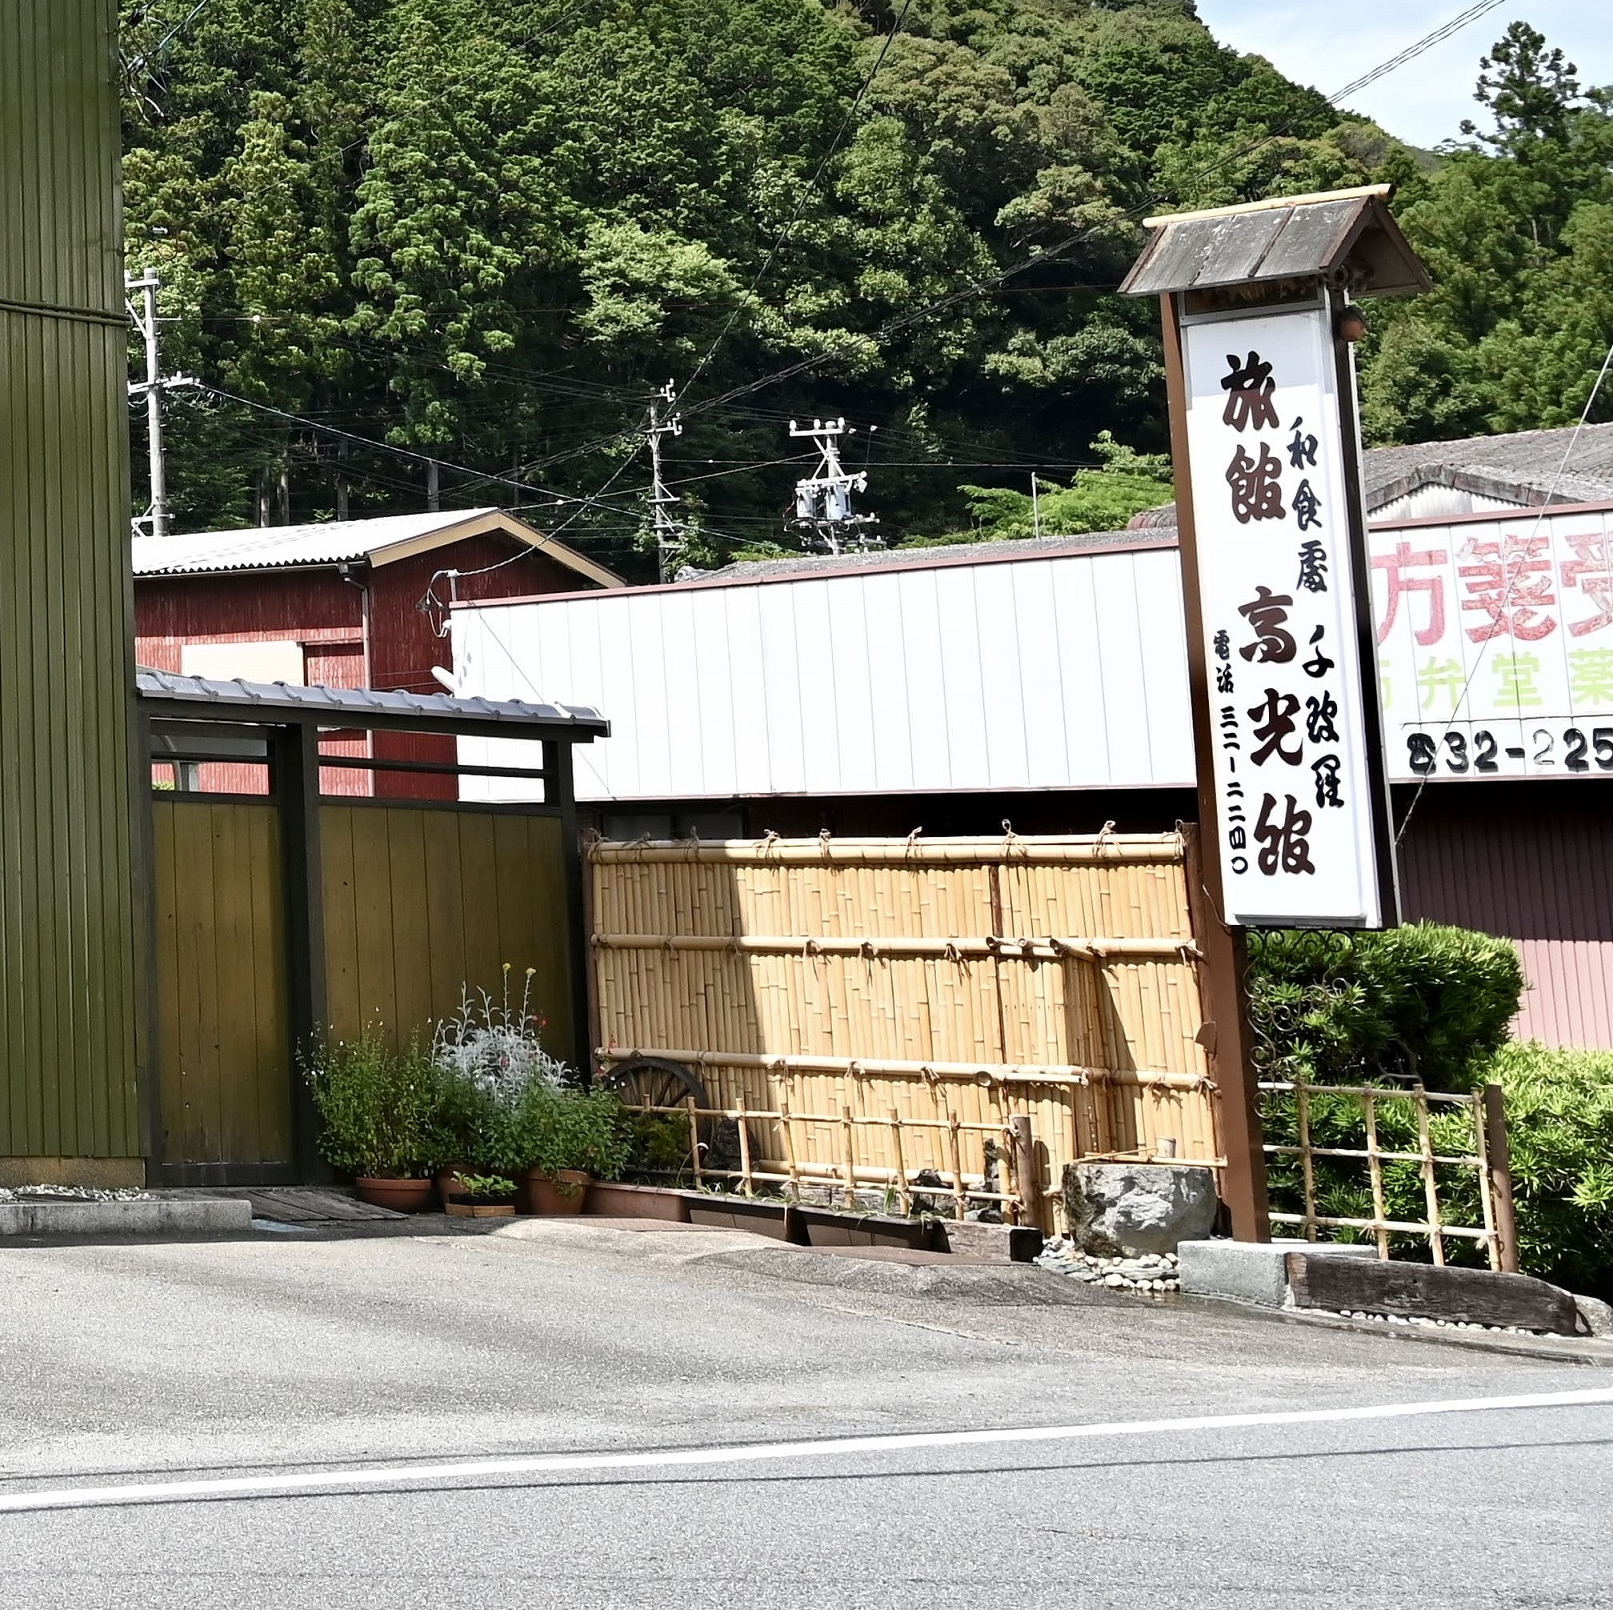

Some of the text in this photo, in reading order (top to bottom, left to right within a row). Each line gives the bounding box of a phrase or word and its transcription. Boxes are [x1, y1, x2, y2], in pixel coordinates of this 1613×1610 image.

[1213, 629, 1235, 694] 電話
[1220, 350, 1316, 876] 旅館 高光館
